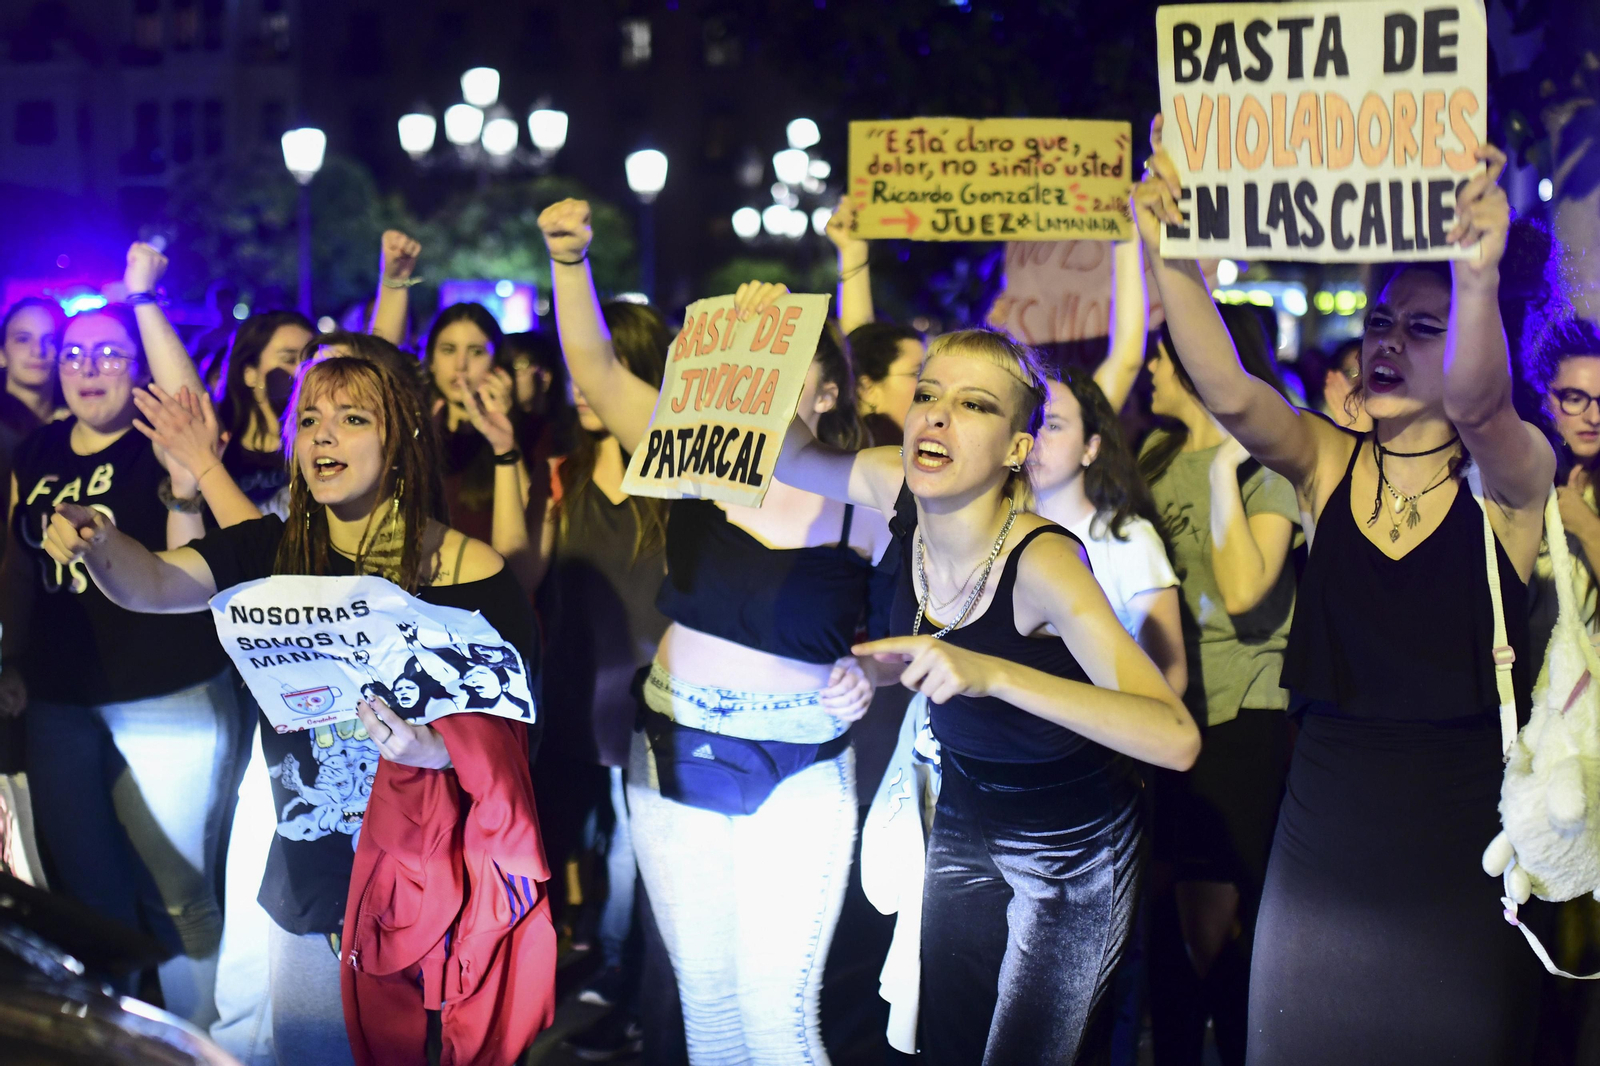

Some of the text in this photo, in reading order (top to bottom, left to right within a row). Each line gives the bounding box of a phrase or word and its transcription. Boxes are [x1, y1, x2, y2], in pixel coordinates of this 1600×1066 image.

[1173, 7, 1460, 84] BASTA DE
[1173, 88, 1480, 172] VIOLADORES
[940, 160, 977, 176] no
[872, 180, 1068, 206] Ricardo González
[1244, 180, 1325, 249] LAS
[1331, 178, 1472, 253] CALLE
[673, 306, 803, 363] BAST DE
[26, 463, 115, 507] FAB
[230, 600, 371, 626] NOSOTRAS
[236, 631, 372, 652] SOMOS LA
